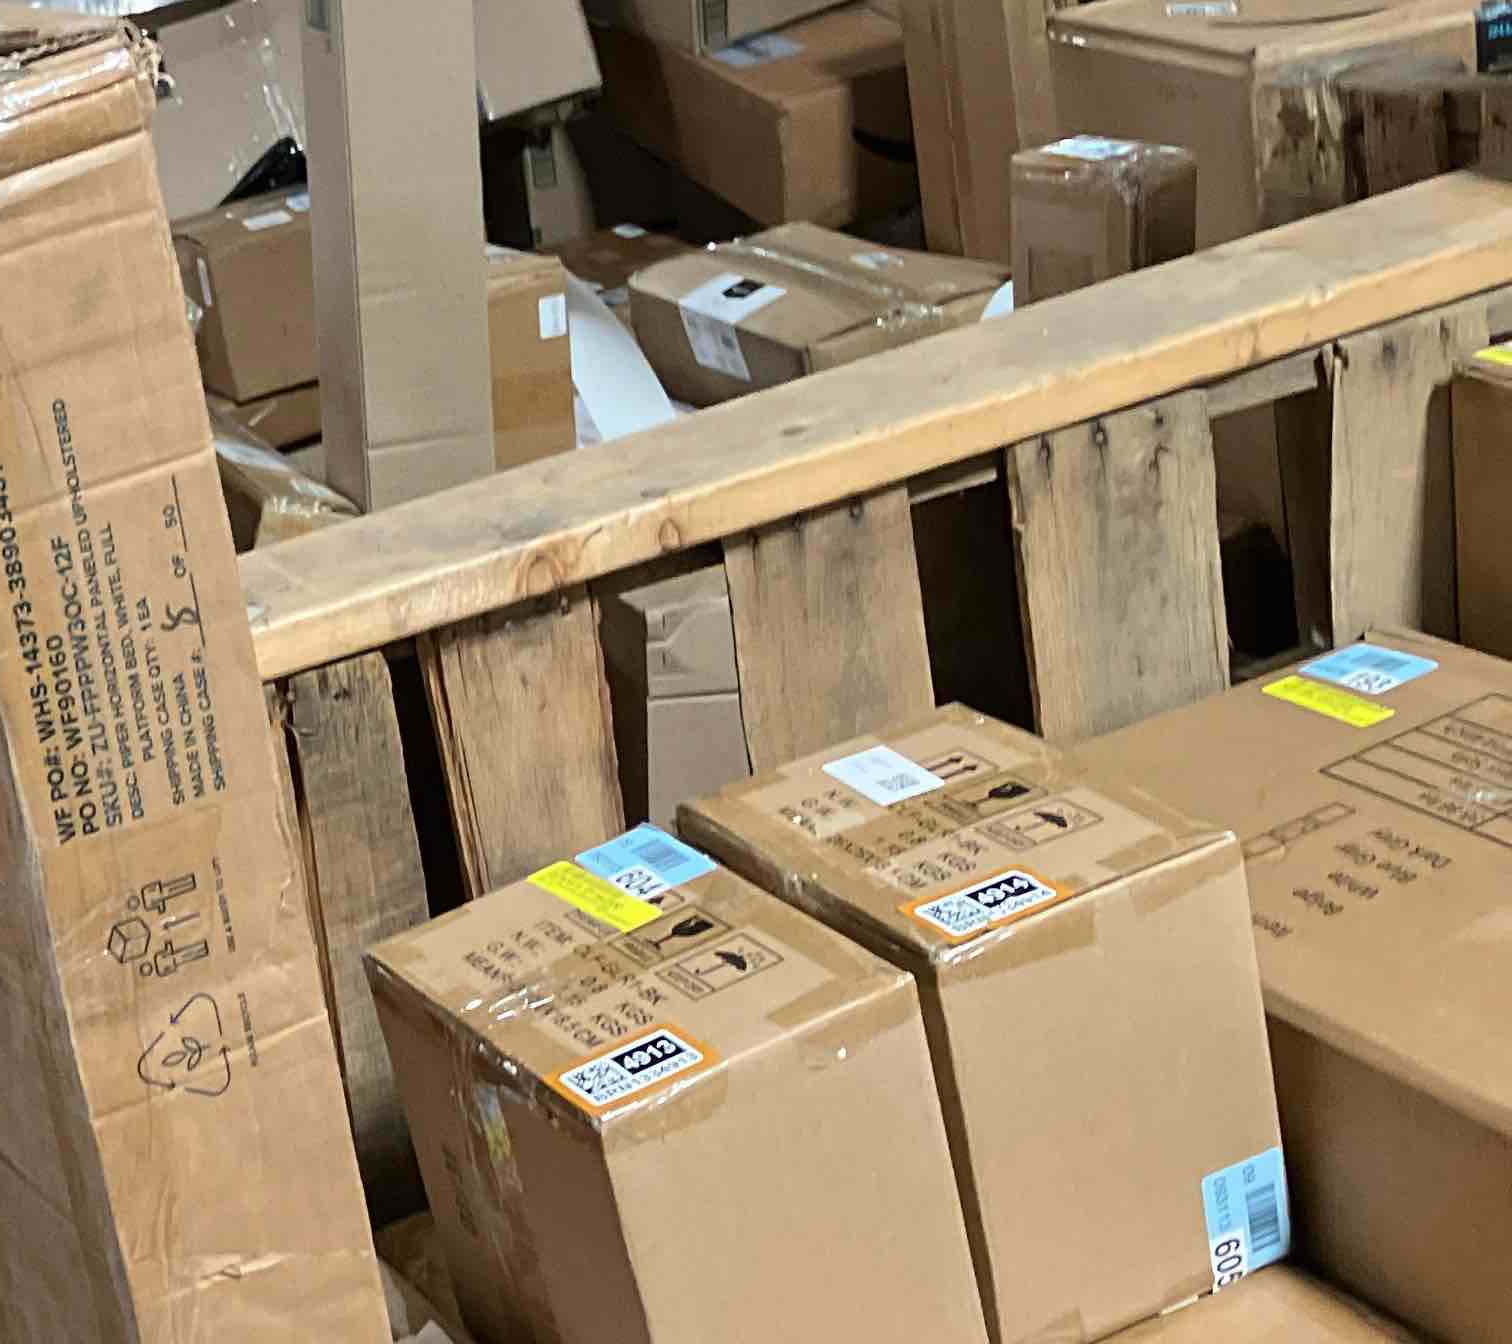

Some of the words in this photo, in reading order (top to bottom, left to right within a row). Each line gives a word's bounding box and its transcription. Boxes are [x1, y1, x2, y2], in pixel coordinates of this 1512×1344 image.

[50, 399, 87, 524] UPHOLSTERED
[76, 528, 103, 607] PANELED
[98, 523, 117, 565] FULL
[170, 553, 186, 578] OF
[92, 608, 125, 718] HORIZONTAL
[45, 634, 83, 749] WF90160
[150, 679, 170, 725] CASE
[171, 672, 193, 726] CHINA
[192, 667, 211, 711] CASE
[127, 671, 156, 761] PLATFORM
[182, 729, 196, 747] IN
[114, 721, 135, 768] PIPER
[159, 727, 185, 805] SHIPPING
[201, 714, 227, 791] SHIPPING
[43, 745, 68, 801] PO#:
[69, 752, 92, 796] NO:
[186, 750, 207, 798] MADE
[53, 806, 77, 843] WF
[78, 801, 99, 835] PO
